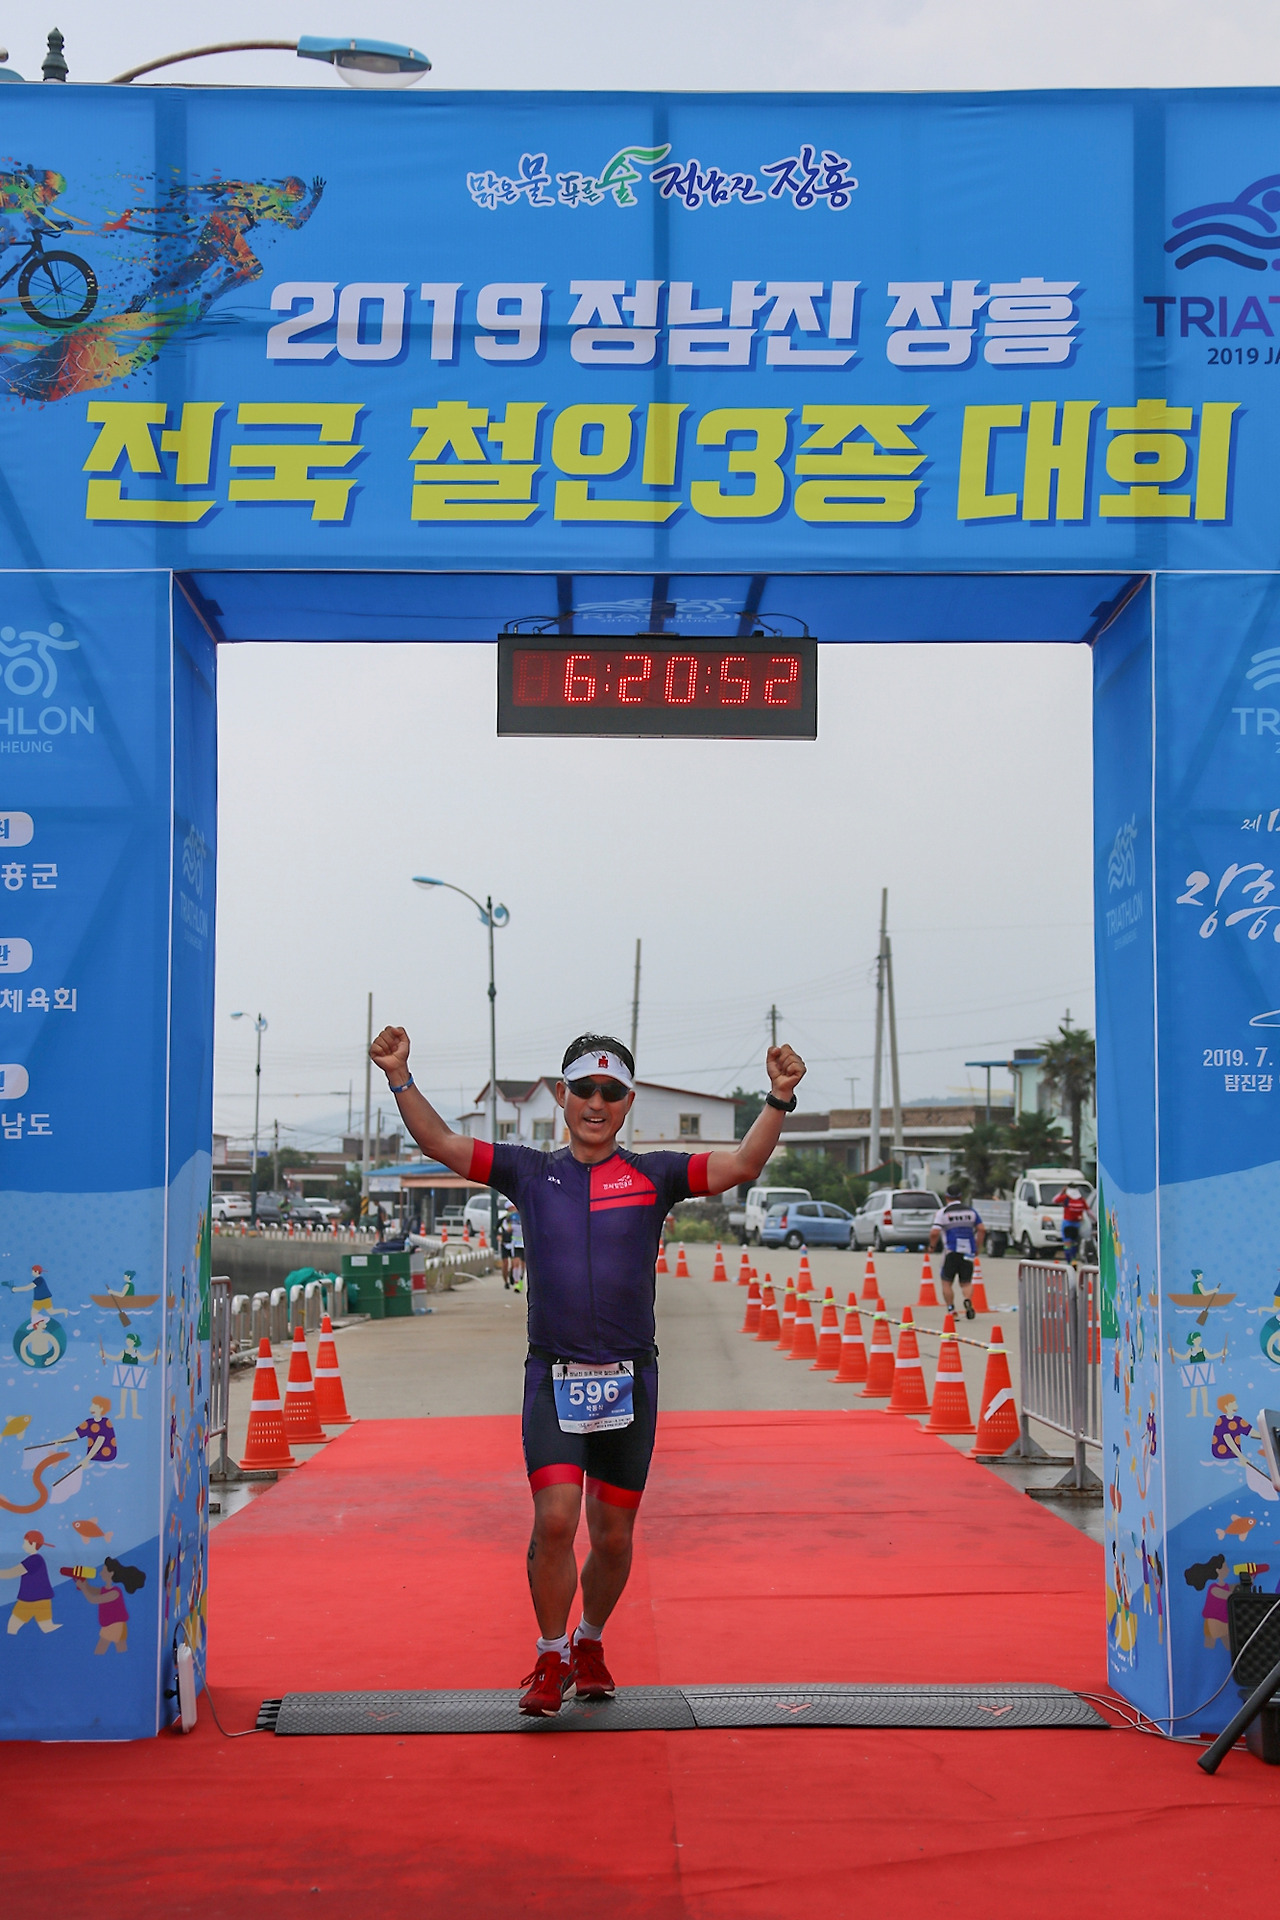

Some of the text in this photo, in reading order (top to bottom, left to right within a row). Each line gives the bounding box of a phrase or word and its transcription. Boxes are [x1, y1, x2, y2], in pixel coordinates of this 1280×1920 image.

[469, 172, 518, 208] 맑은
[516, 154, 552, 204] 물
[558, 174, 600, 205] 푸른
[652, 162, 763, 208] 정남진
[763, 146, 856, 209] 장흥
[266, 277, 1080, 366] 2019 정남진 장흥
[1207, 347, 1259, 365] 2019
[82, 399, 1242, 522] 전국 철인3종 대회
[563, 655, 799, 703] 6:20:52
[0, 740, 53, 753] HEUNG
[1, 862, 58, 891] 흥군
[0, 987, 77, 1013] 체육회
[1203, 1046, 1274, 1067] 2019. 7.
[1224, 1074, 1273, 1092] 탐진강
[1, 1112, 53, 1139] 남도
[569, 1380, 619, 1406] 596
